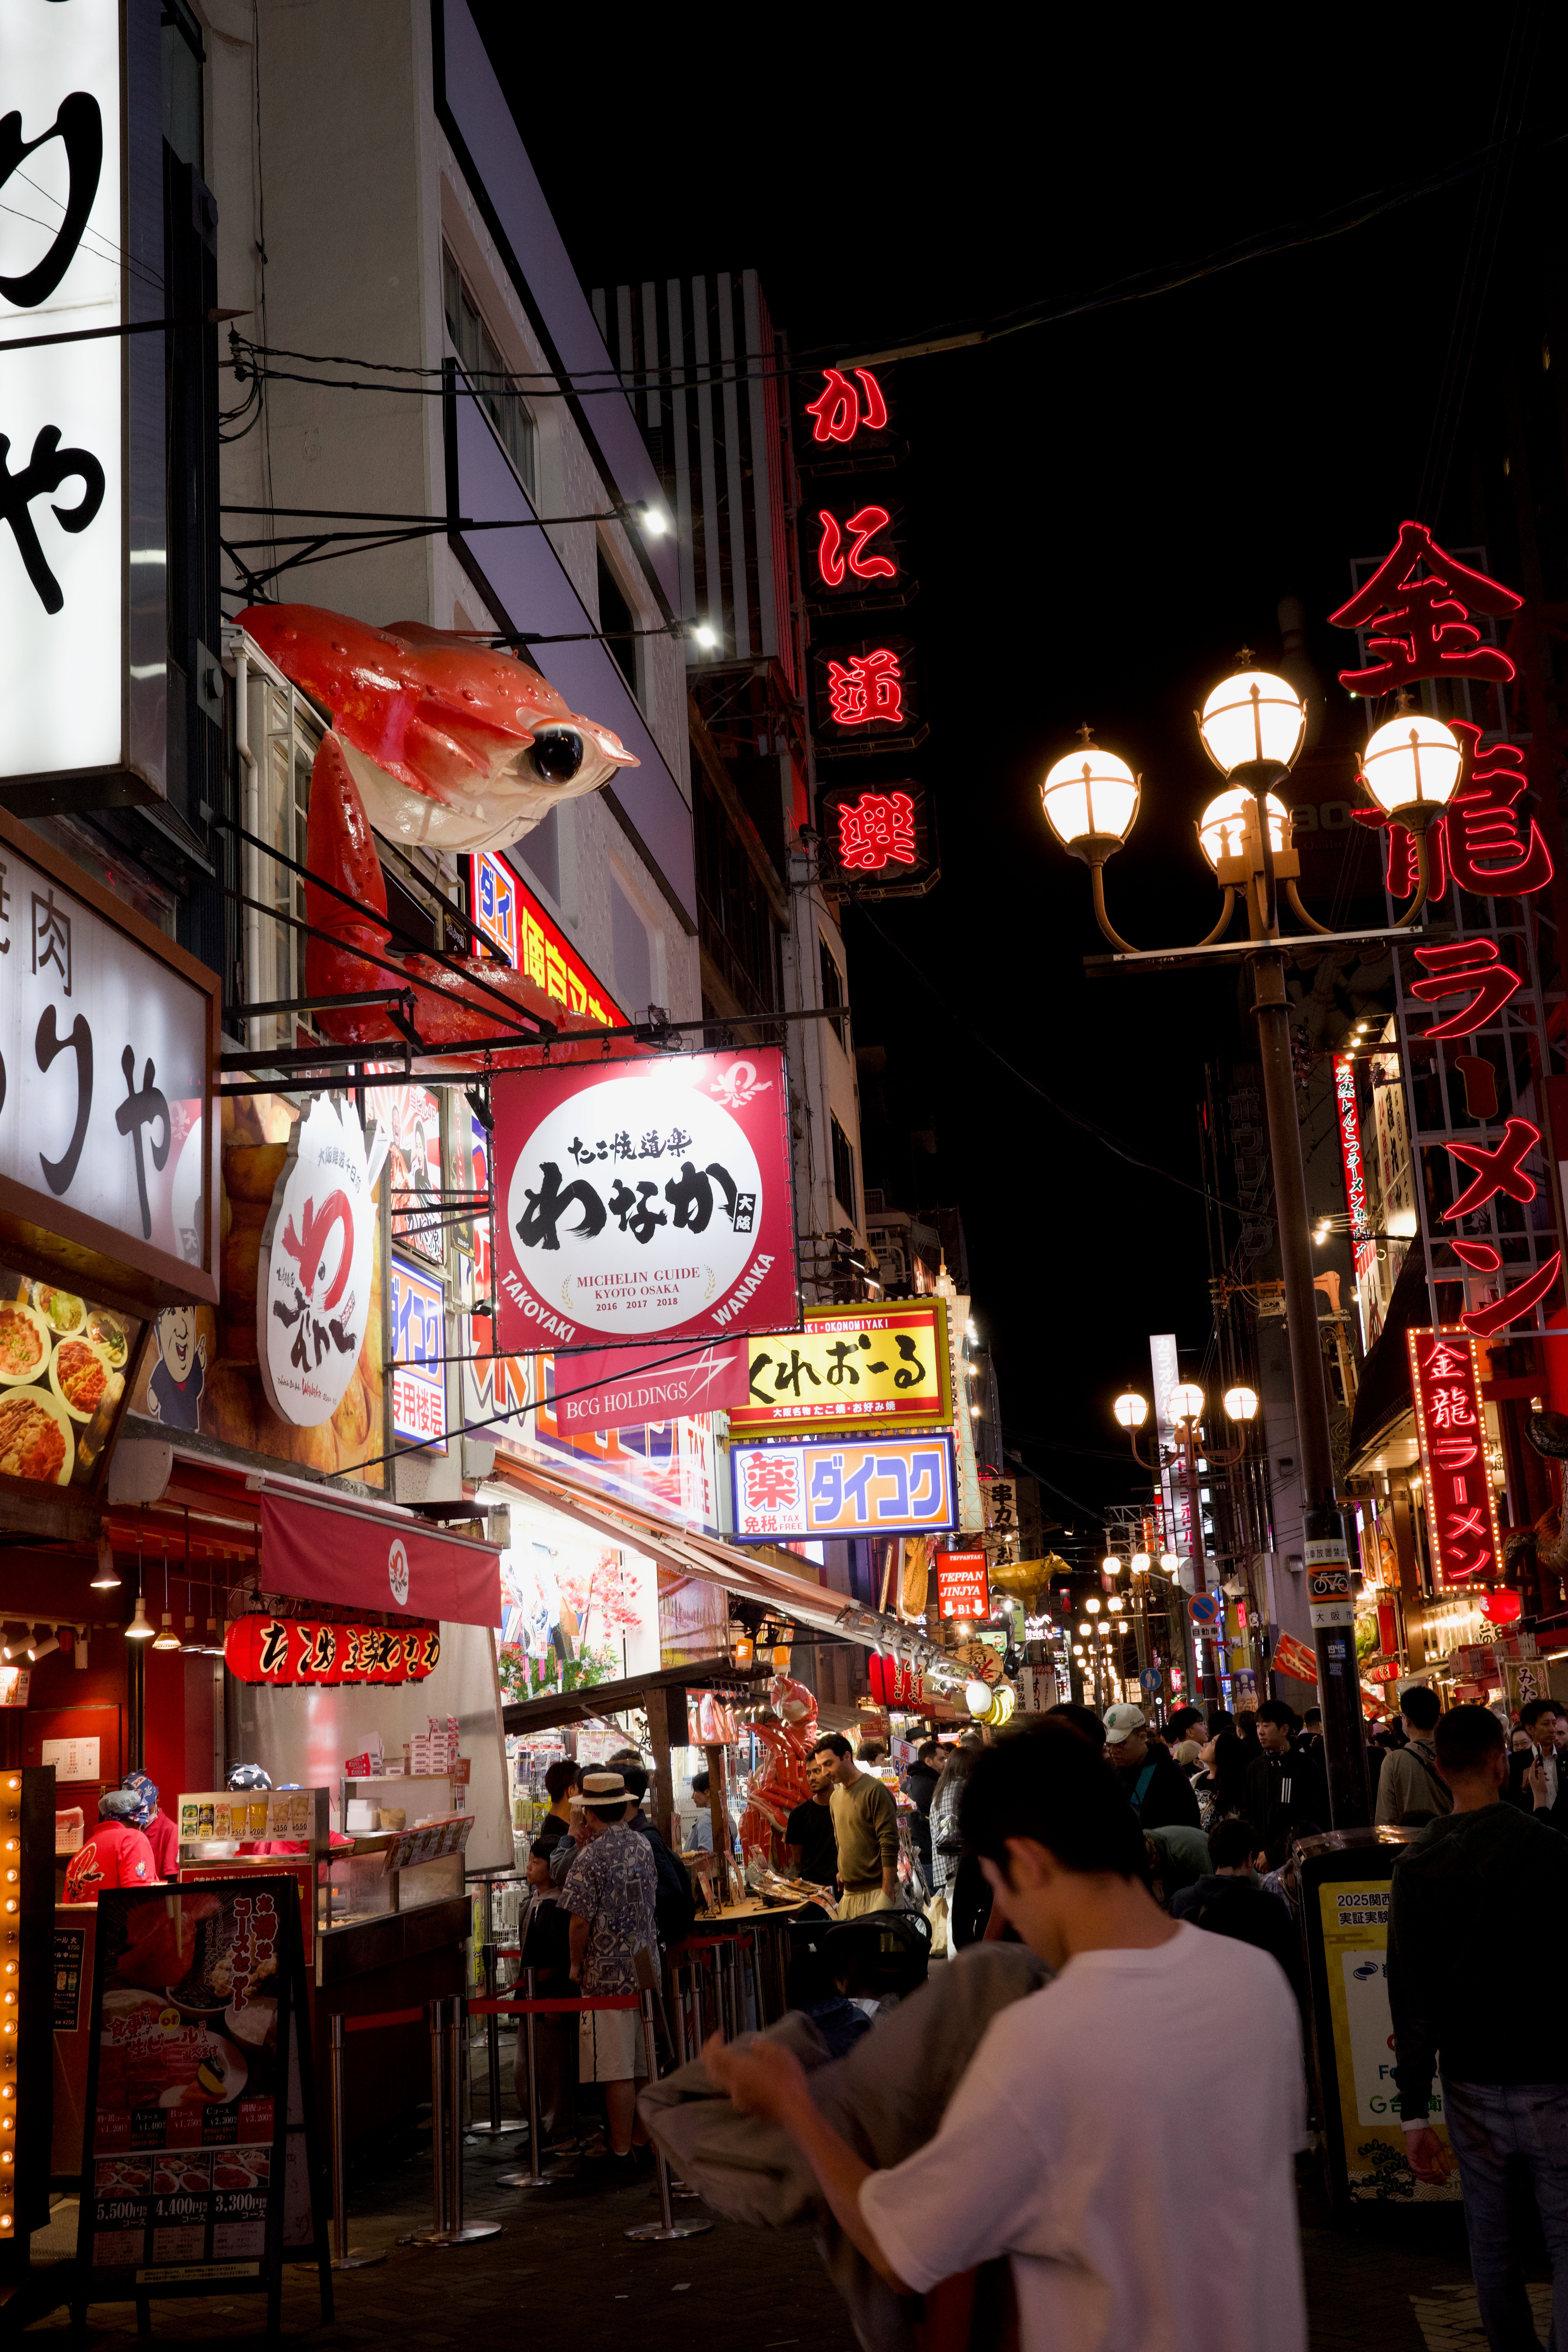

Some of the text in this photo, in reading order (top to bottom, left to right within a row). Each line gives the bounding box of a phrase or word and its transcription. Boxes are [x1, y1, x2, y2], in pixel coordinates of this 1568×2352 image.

[0, 0, 105, 615] りや
[1327, 520, 1563, 1338] 金龍ラーメン
[0, 1004, 171, 1241] りや
[568, 1127, 692, 1167] たこ焼道楽
[318, 1145, 361, 1194] 大阪難波千日前
[515, 1161, 739, 1252] わなか
[576, 1267, 700, 1289] MICHELIN GUIDE
[594, 1284, 680, 1300] KYOTO OSAKA
[711, 1253, 775, 1326] WANAKA
[501, 1269, 576, 1343] TAKOYAKI
[596, 1297, 678, 1312] 2016 2017 2018
[750, 1334, 926, 1404] くれおーる
[566, 1381, 688, 1419] BCG HOLDINGS
[773, 1401, 896, 1418] 大阪名物 たこ焼・お好み焼
[688, 1429, 706, 1471] TAX
[1422, 1341, 1491, 1580] 金龍ラーメン
[746, 1452, 795, 1508] 薬
[810, 1453, 944, 1524] ダイコク
[744, 1516, 777, 1533] 免税
[780, 1522, 803, 1530] FREE
[940, 1571, 984, 1583] TEPPAN
[940, 1585, 981, 1597] JINJYA
[957, 1604, 971, 1615] B1
[1316, 1610, 1352, 1622] 大阪市
[1192, 1627, 1219, 1636] 自動車
[231, 1898, 252, 2012] コースセット
[161, 2013, 178, 2027] or
[127, 2025, 198, 2058] 生ビール
[122, 2218, 146, 2228] コース
[182, 2214, 206, 2223] コース
[242, 2210, 265, 2220] コース
